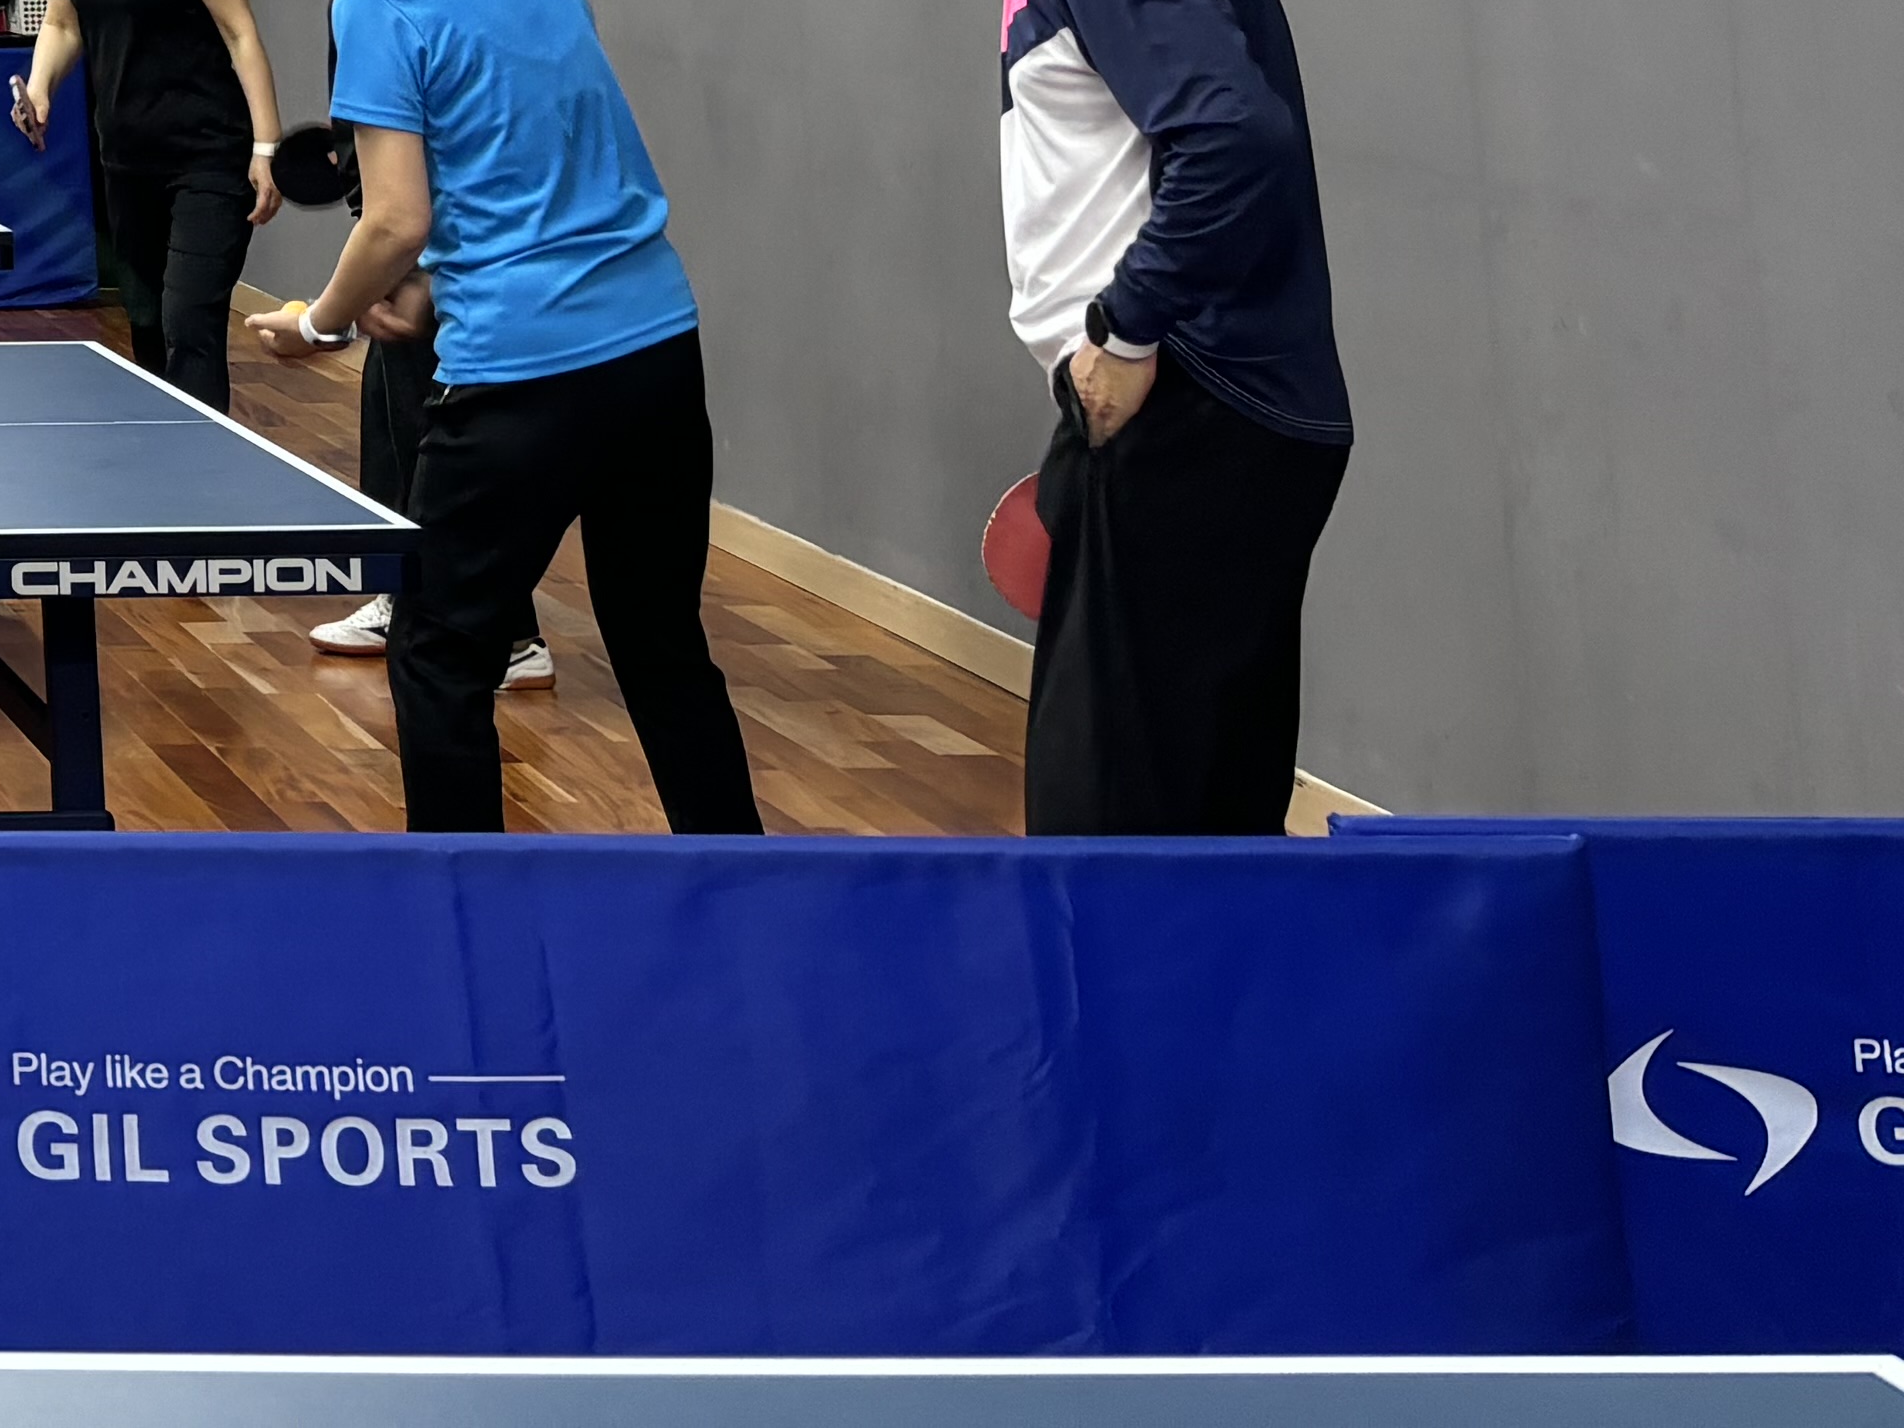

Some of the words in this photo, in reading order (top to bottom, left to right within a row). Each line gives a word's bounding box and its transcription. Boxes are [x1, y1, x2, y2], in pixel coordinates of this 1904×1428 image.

[11, 557, 362, 596] CHAMPION
[12, 1052, 95, 1096] Play
[105, 1054, 169, 1089] like
[179, 1063, 205, 1090] a
[213, 1055, 414, 1101] Champion
[17, 1110, 170, 1183] GIL
[196, 1114, 577, 1188] SPORTS
